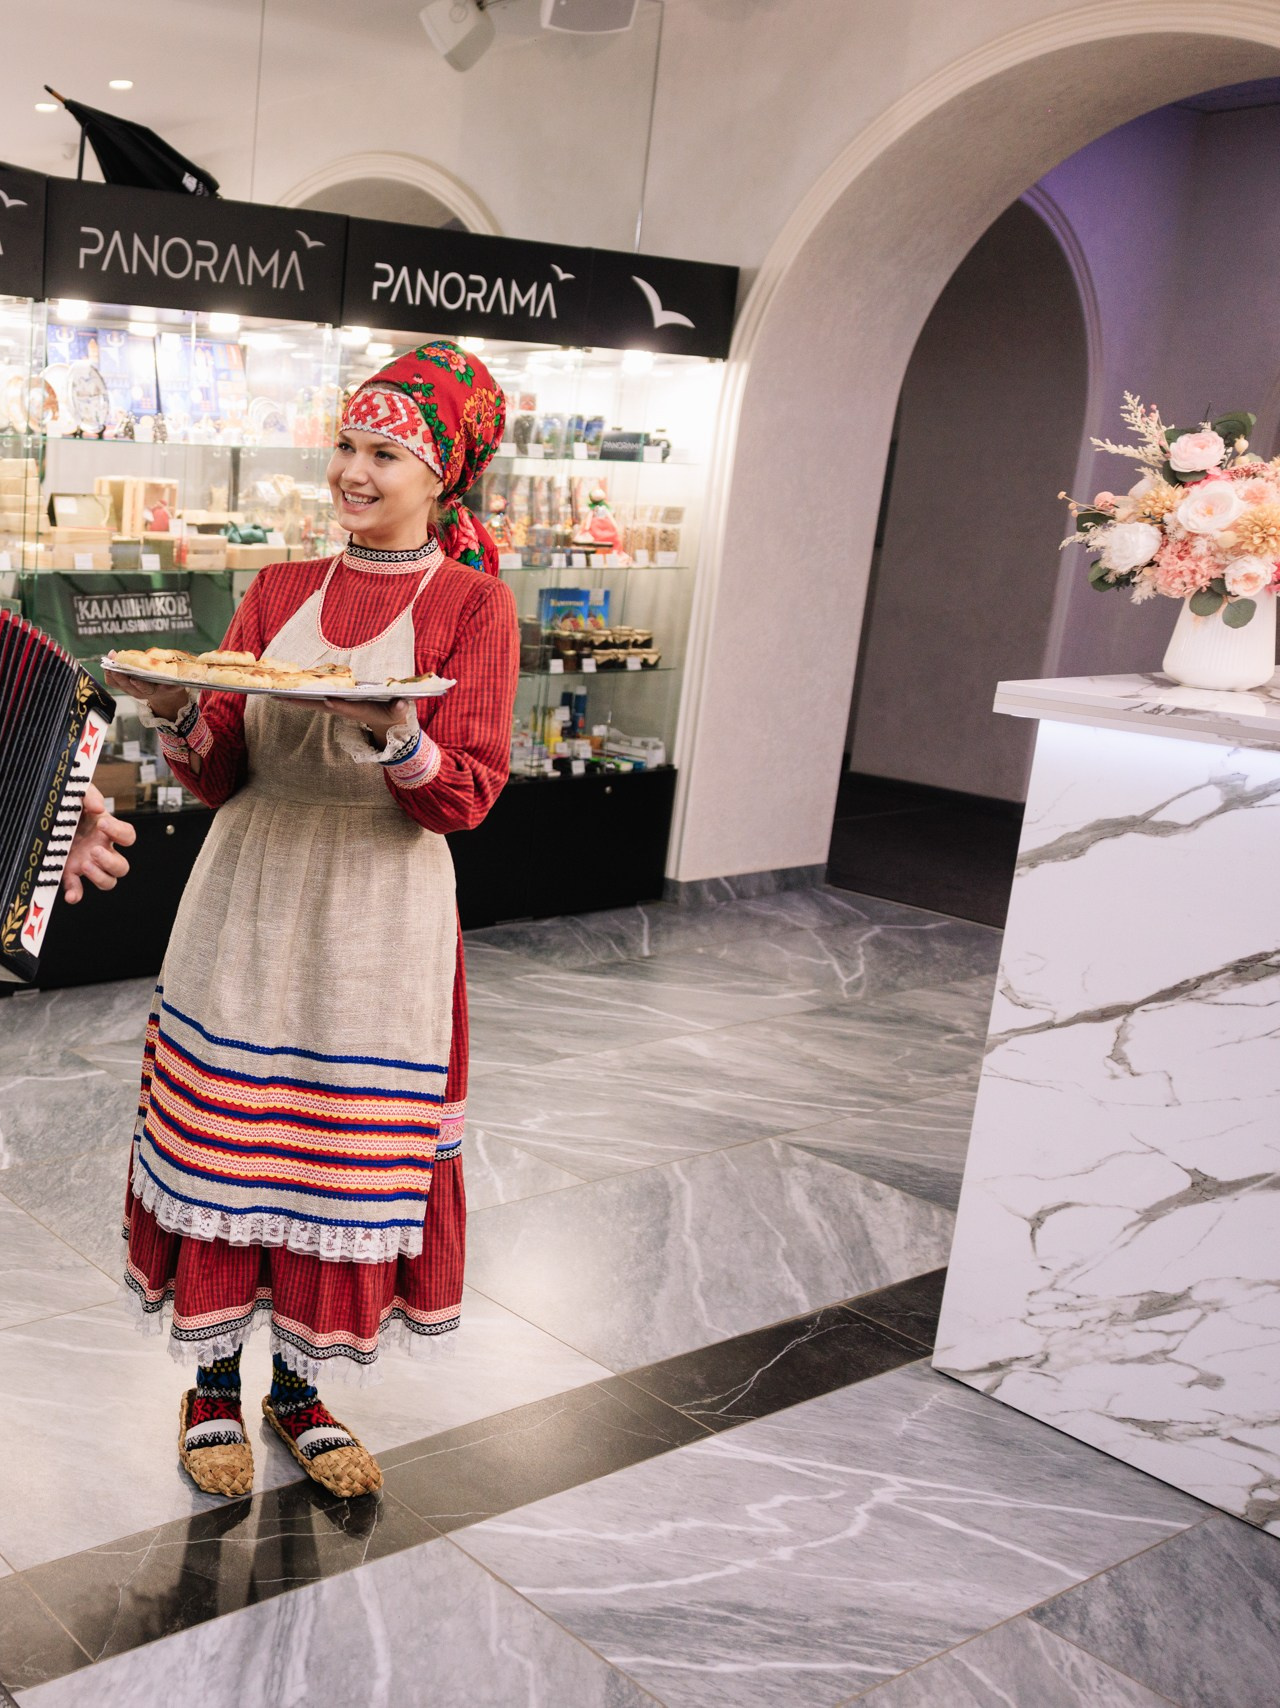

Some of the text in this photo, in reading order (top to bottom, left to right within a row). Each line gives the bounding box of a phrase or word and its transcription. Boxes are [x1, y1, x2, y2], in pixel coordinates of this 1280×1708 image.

[78, 226, 305, 291] PANORAMA
[371, 262, 558, 319] PANORAMA
[78, 596, 188, 620] КАЛАШНИКОВ
